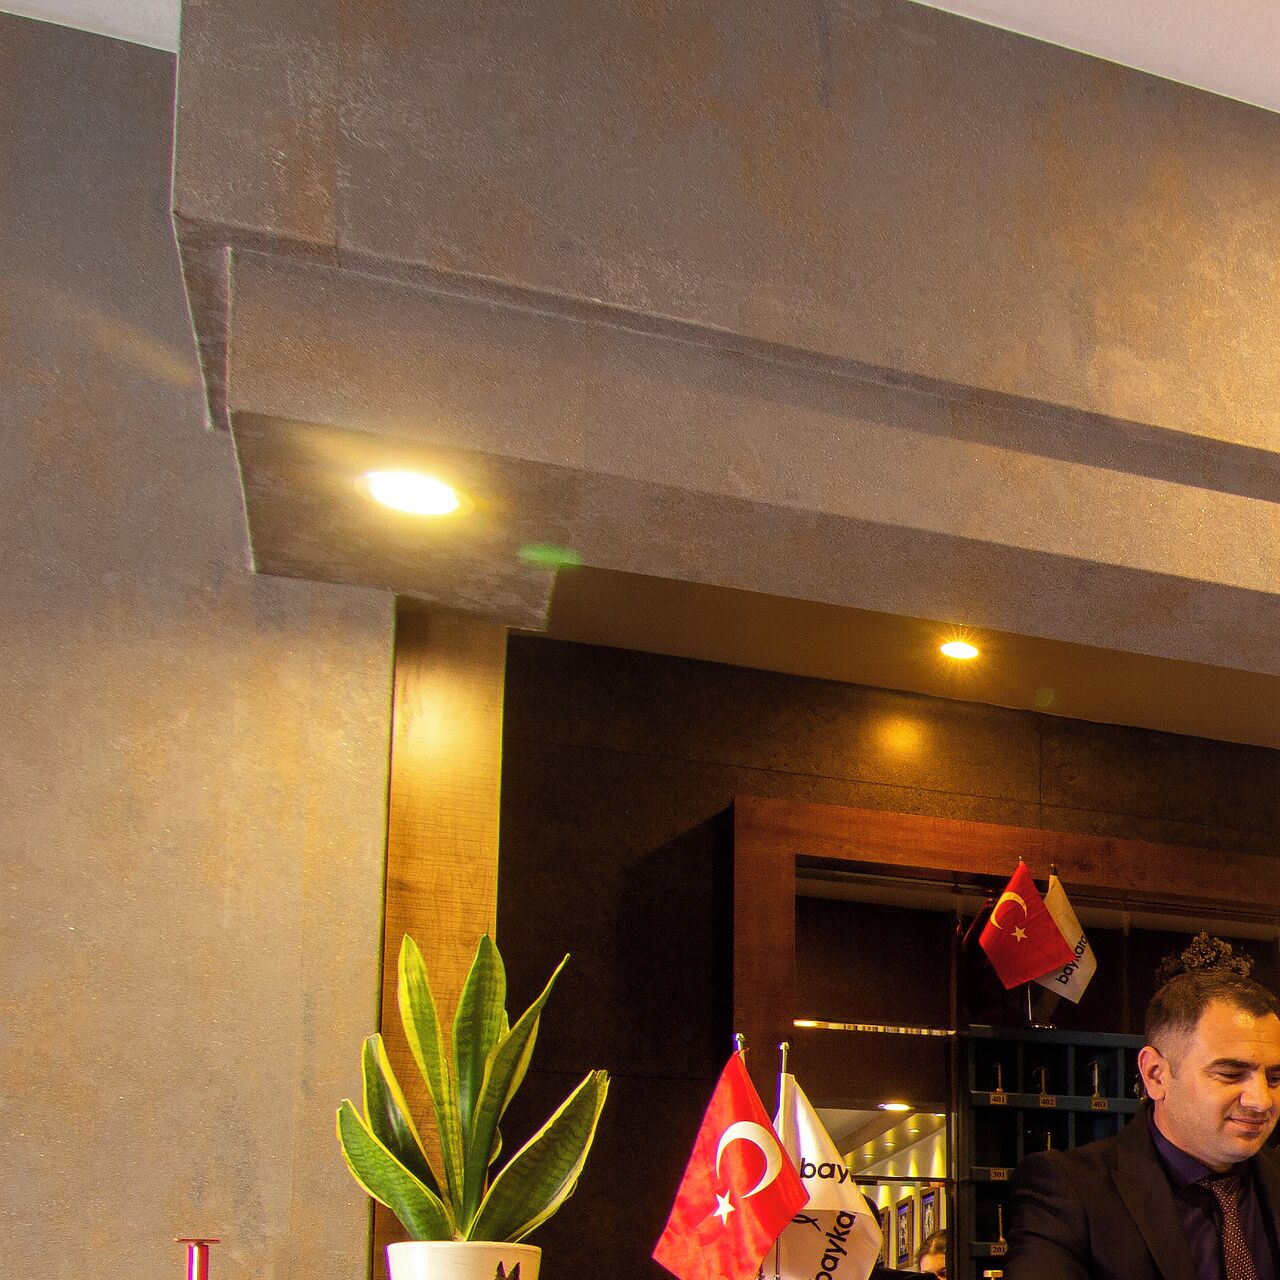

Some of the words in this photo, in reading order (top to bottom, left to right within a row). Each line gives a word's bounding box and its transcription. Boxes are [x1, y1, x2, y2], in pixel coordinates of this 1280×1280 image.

[991, 1095, 1006, 1104] 401
[1040, 1097, 1055, 1106] 402
[1092, 1100, 1107, 1109] 403
[991, 1171, 1006, 1179] 301
[991, 1246, 1006, 1254] 201
